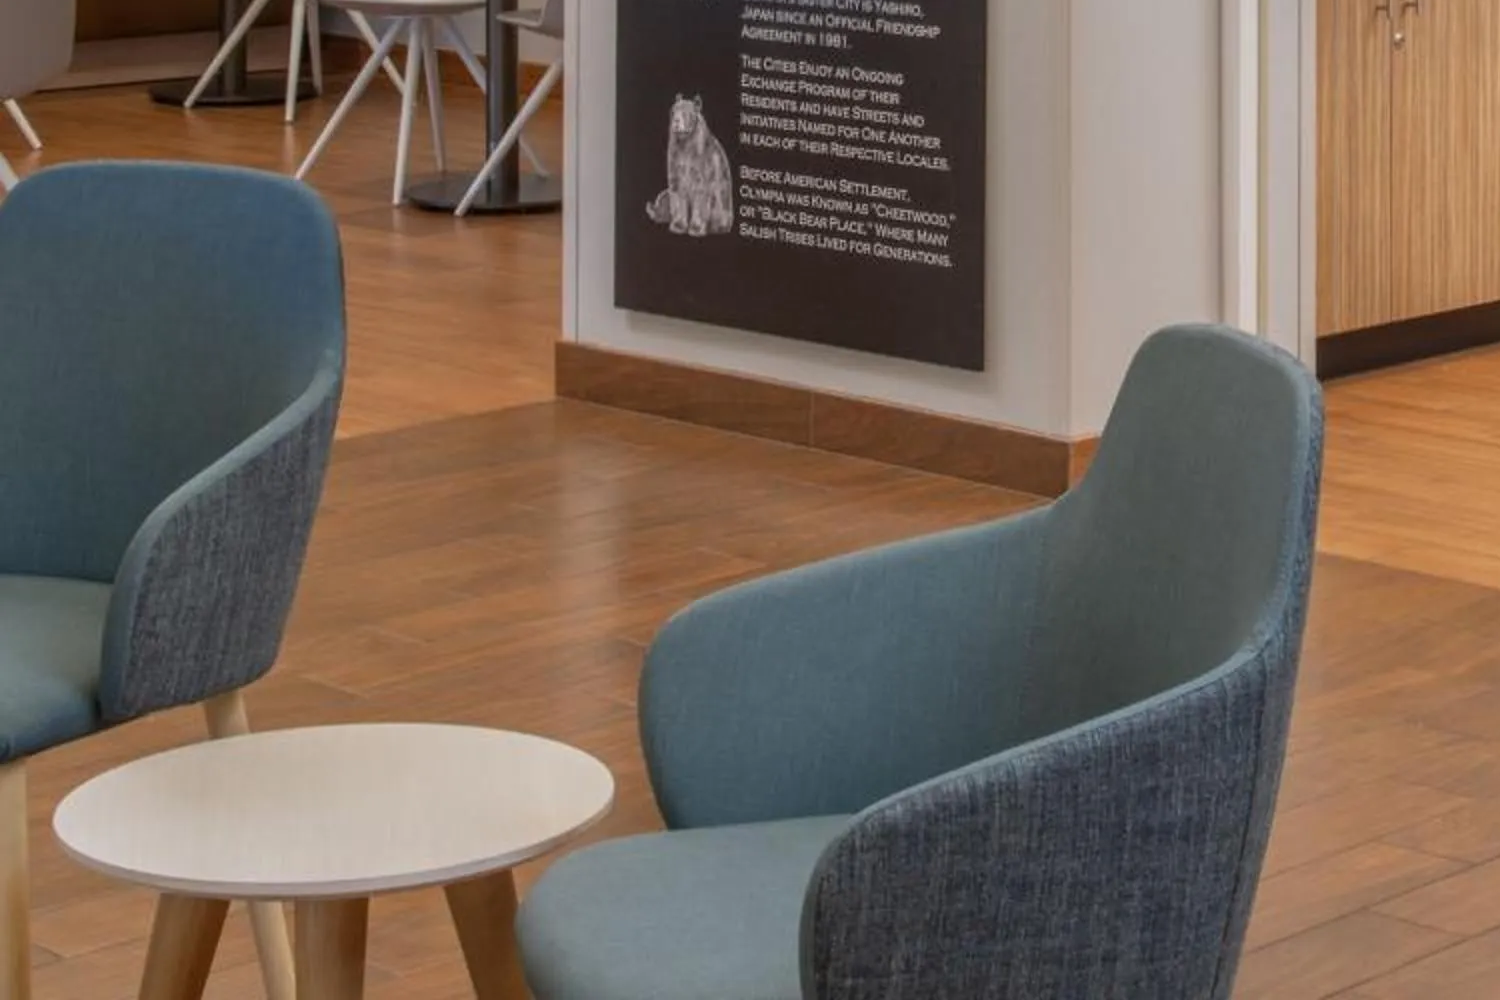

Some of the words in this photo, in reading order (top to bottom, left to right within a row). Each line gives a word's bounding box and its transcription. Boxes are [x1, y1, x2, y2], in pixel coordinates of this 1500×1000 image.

[862, 0, 873, 11] IS
[741, 7, 773, 22] JAPAN
[774, 9, 806, 25] SINCE
[806, 13, 823, 27] AN
[826, 13, 874, 33] OFFICIAL
[875, 19, 940, 39] FRIENDSHIP
[741, 26, 802, 44] AGREEMENT
[805, 32, 816, 44] IN
[742, 55, 762, 70] THE
[763, 56, 796, 73] CITIES
[799, 61, 833, 76] ENJOY
[835, 66, 849, 80] AN
[852, 66, 904, 85] ONGOING
[741, 74, 796, 93] EXCHANGE
[798, 80, 850, 100] PROGRAM
[853, 87, 868, 100] OF
[870, 89, 900, 104] THEIR
[741, 93, 797, 112] RESIDENTS
[800, 100, 820, 115] AND
[823, 103, 850, 118] HAVE
[852, 105, 901, 125] STREETS
[902, 113, 925, 127] AND
[741, 113, 796, 132] INITIATIVES
[798, 117, 836, 136] NAMED
[837, 124, 860, 139] FOR
[862, 126, 887, 143] ONE
[888, 129, 941, 149] ANOTHER
[740, 133, 750, 144] IN
[751, 133, 781, 148] EACH
[782, 137, 797, 150] OF
[800, 139, 829, 154] THEIR
[830, 142, 895, 163] RESPECTIVE
[740, 165, 783, 184] BEFORE
[784, 172, 838, 192] AMERICAN
[740, 185, 785, 203] OLYMPIA
[787, 192, 810, 207] WAS
[812, 195, 852, 215] KNOWN
[853, 202, 869, 215] AS
[740, 206, 756, 218] OR
[799, 211, 829, 228] BEAR
[875, 223, 915, 242] WHERE
[917, 229, 949, 247] MANY
[740, 222, 778, 239] SALISH
[779, 228, 815, 247] TRIBES
[817, 234, 848, 251] LIVED
[850, 239, 871, 254] FOR
